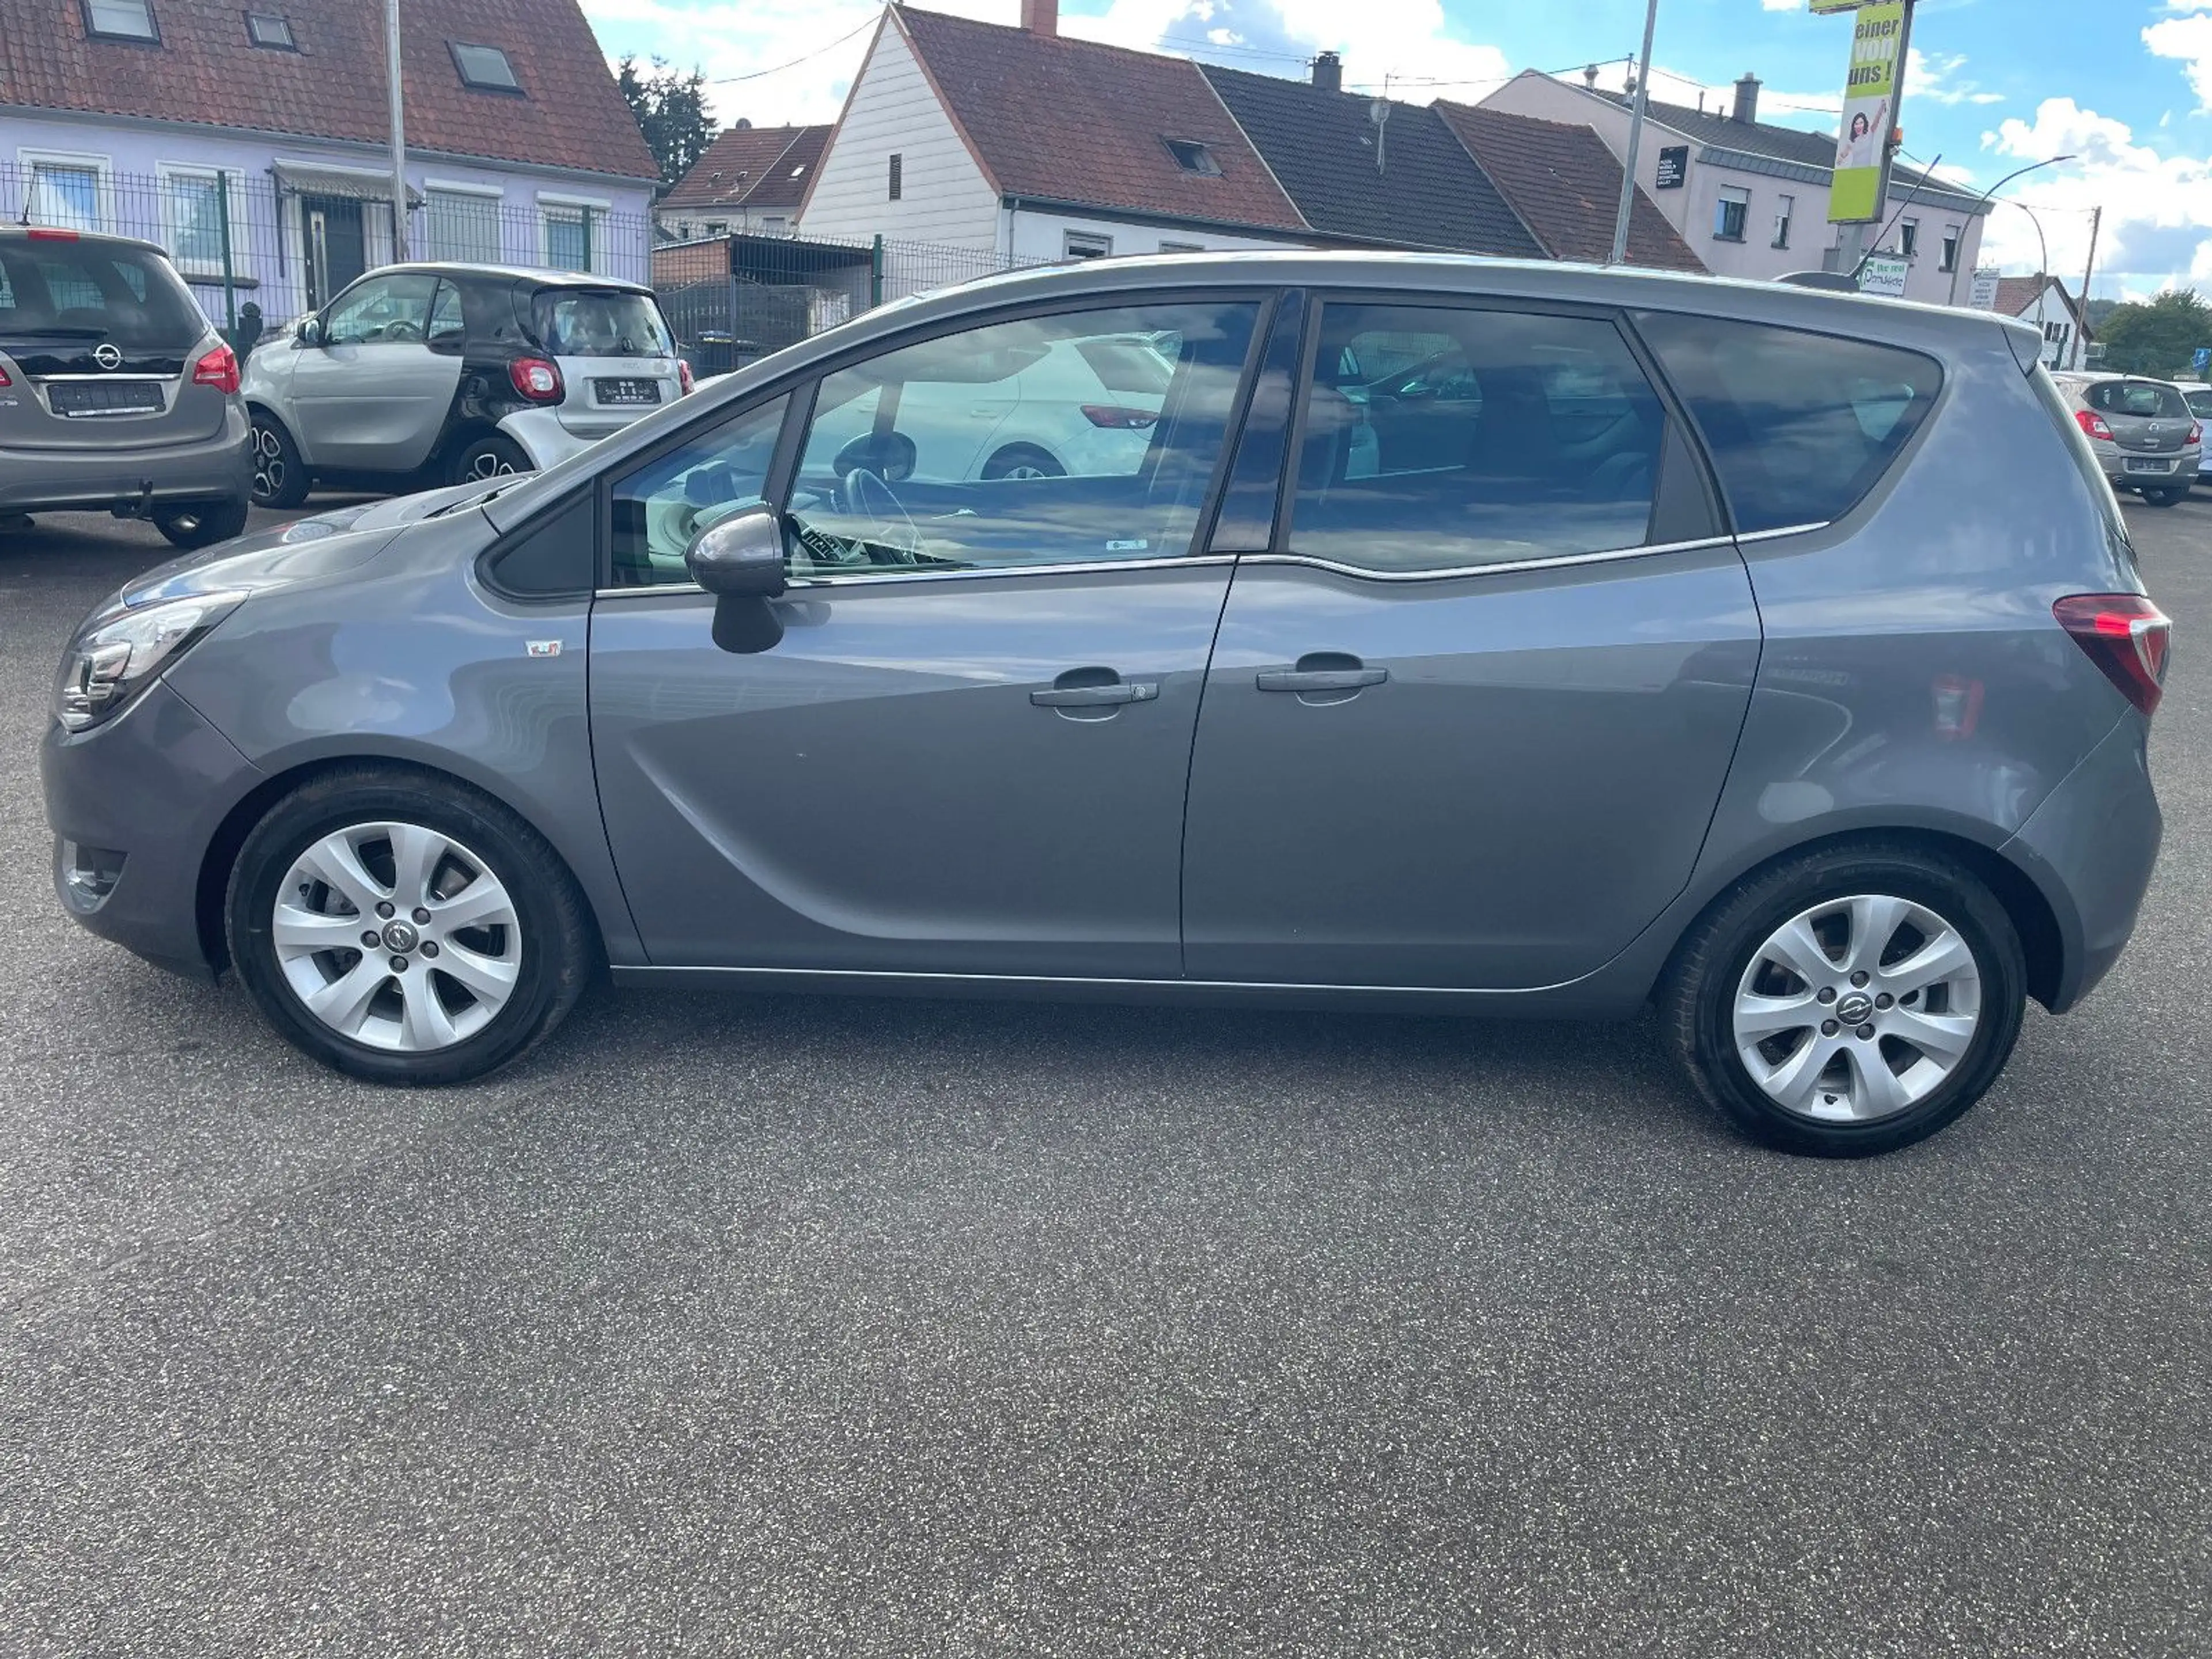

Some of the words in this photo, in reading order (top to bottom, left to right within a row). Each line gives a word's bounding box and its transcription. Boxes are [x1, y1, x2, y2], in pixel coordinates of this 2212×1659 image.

[1855, 19, 1899, 39] einer
[1855, 38, 1893, 63] von
[1848, 65, 1881, 86] uns
